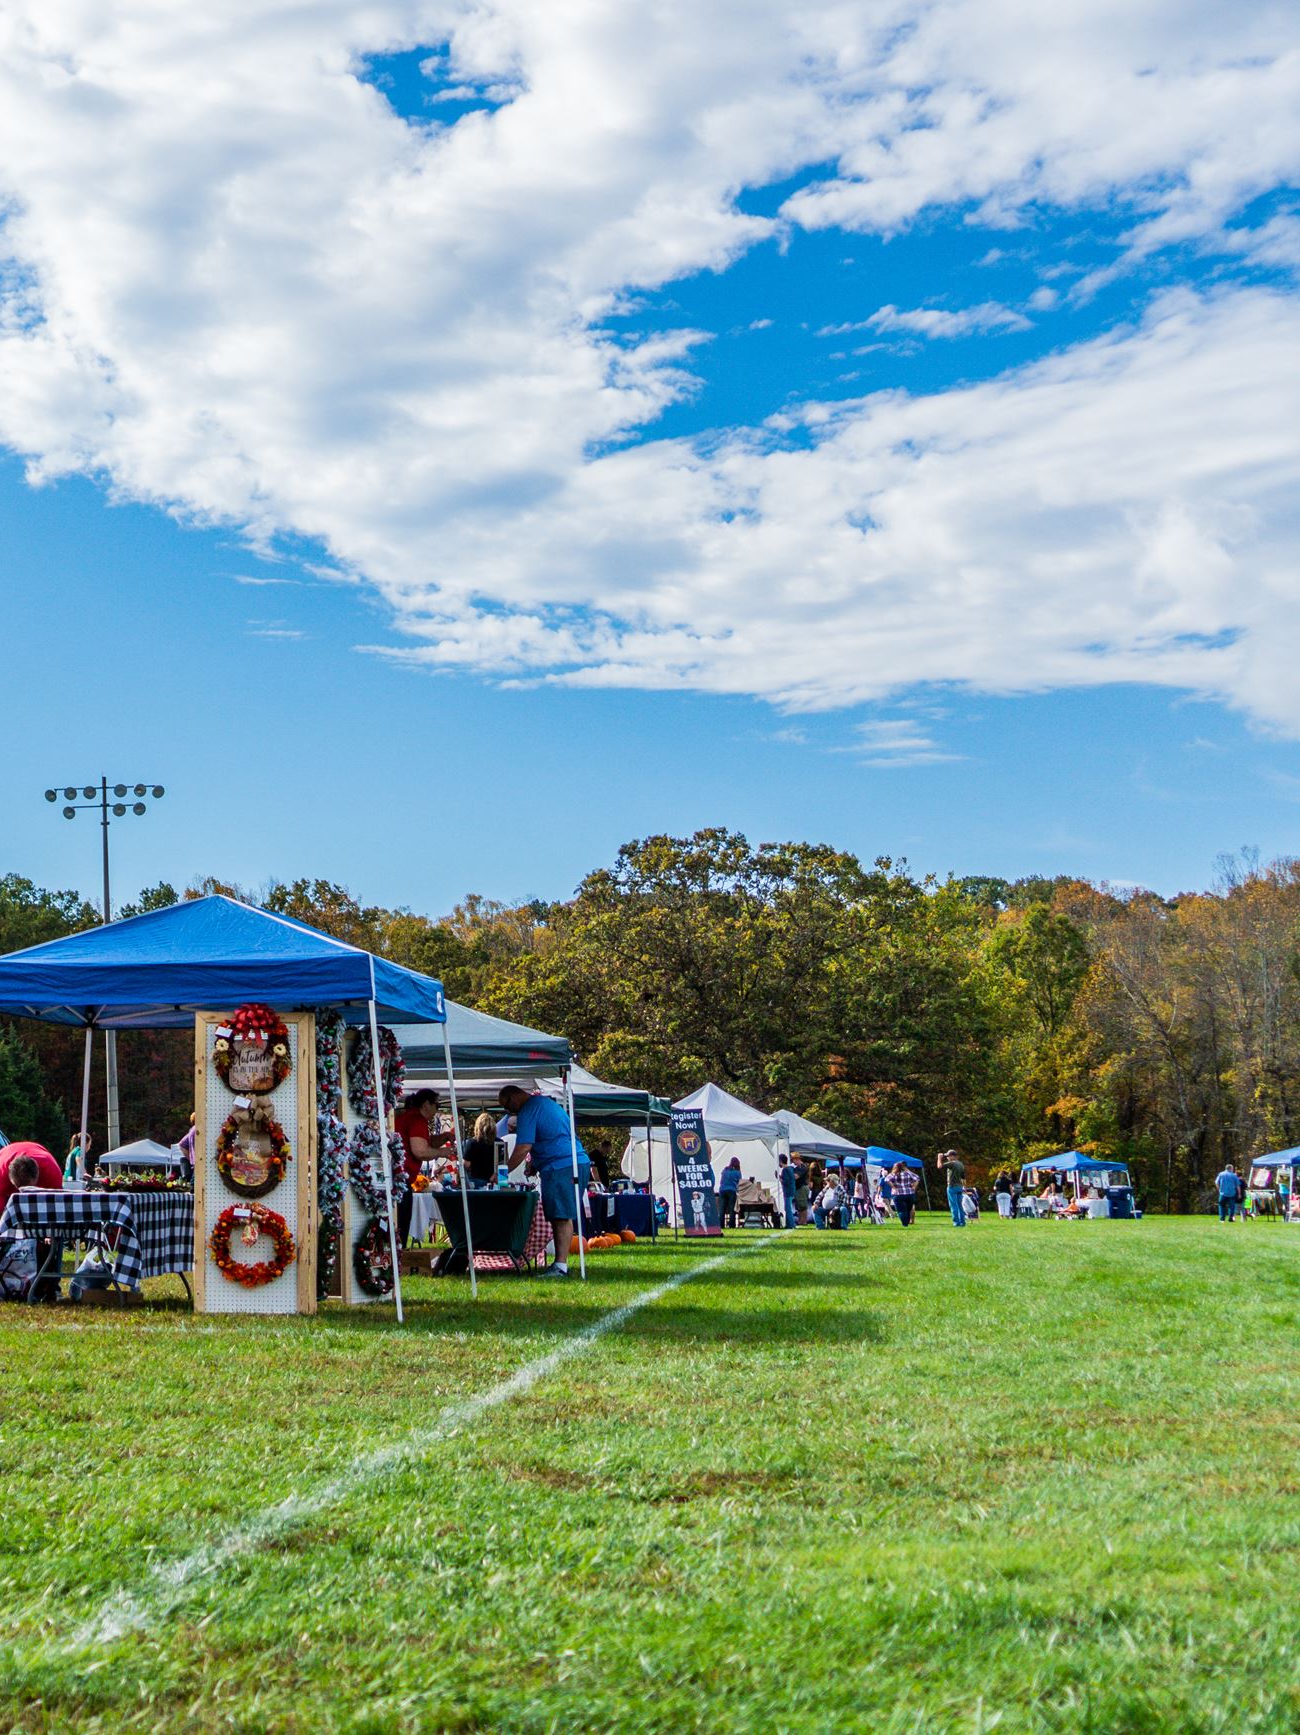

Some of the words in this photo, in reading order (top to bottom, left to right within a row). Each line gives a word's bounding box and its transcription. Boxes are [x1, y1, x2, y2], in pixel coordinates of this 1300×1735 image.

[675, 1121, 697, 1129] Now!
[677, 1164, 709, 1173] WEEKS
[685, 1172, 703, 1180] FOR
[679, 1180, 712, 1189] $49.00
